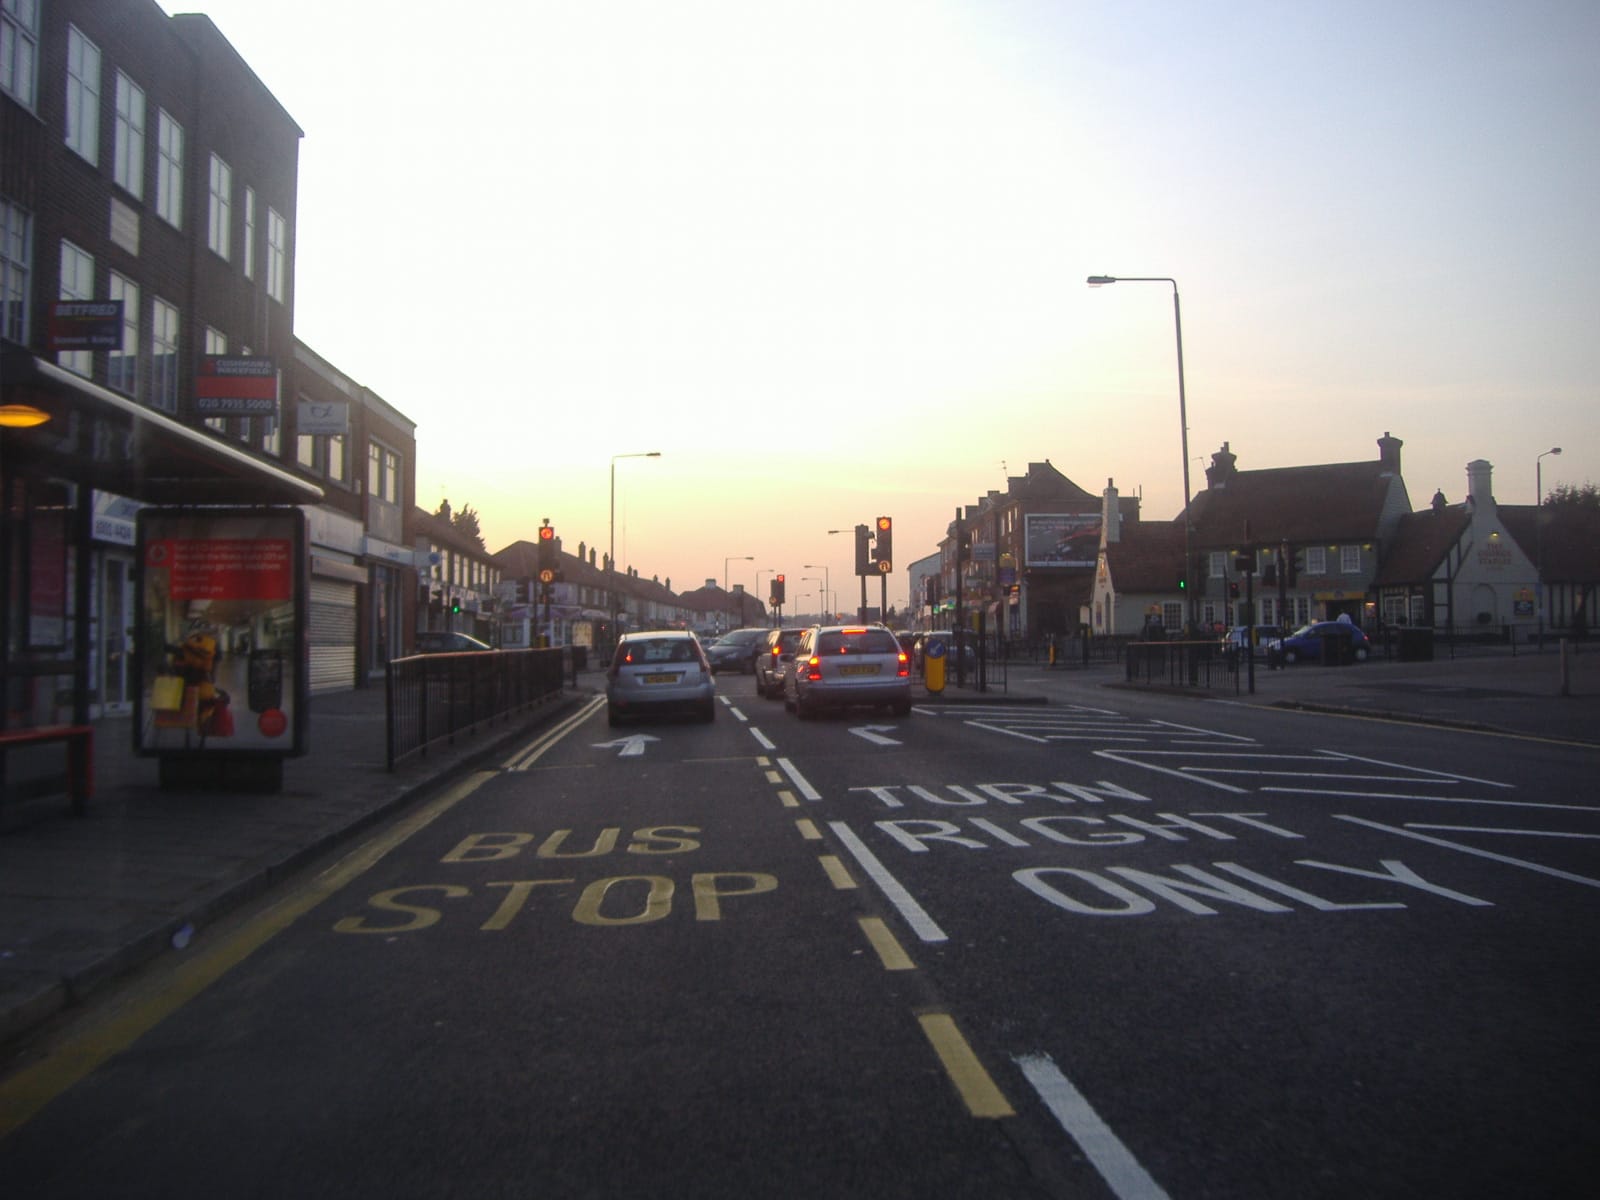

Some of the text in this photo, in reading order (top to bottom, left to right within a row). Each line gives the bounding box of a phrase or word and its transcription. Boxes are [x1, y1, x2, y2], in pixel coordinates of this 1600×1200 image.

[55, 304, 118, 317] BETFRED
[848, 781, 1152, 807] TURN
[440, 825, 702, 863] BUS
[874, 812, 1306, 852] RIGHT
[332, 872, 779, 934] STOP
[1011, 859, 1497, 916] ONLY
